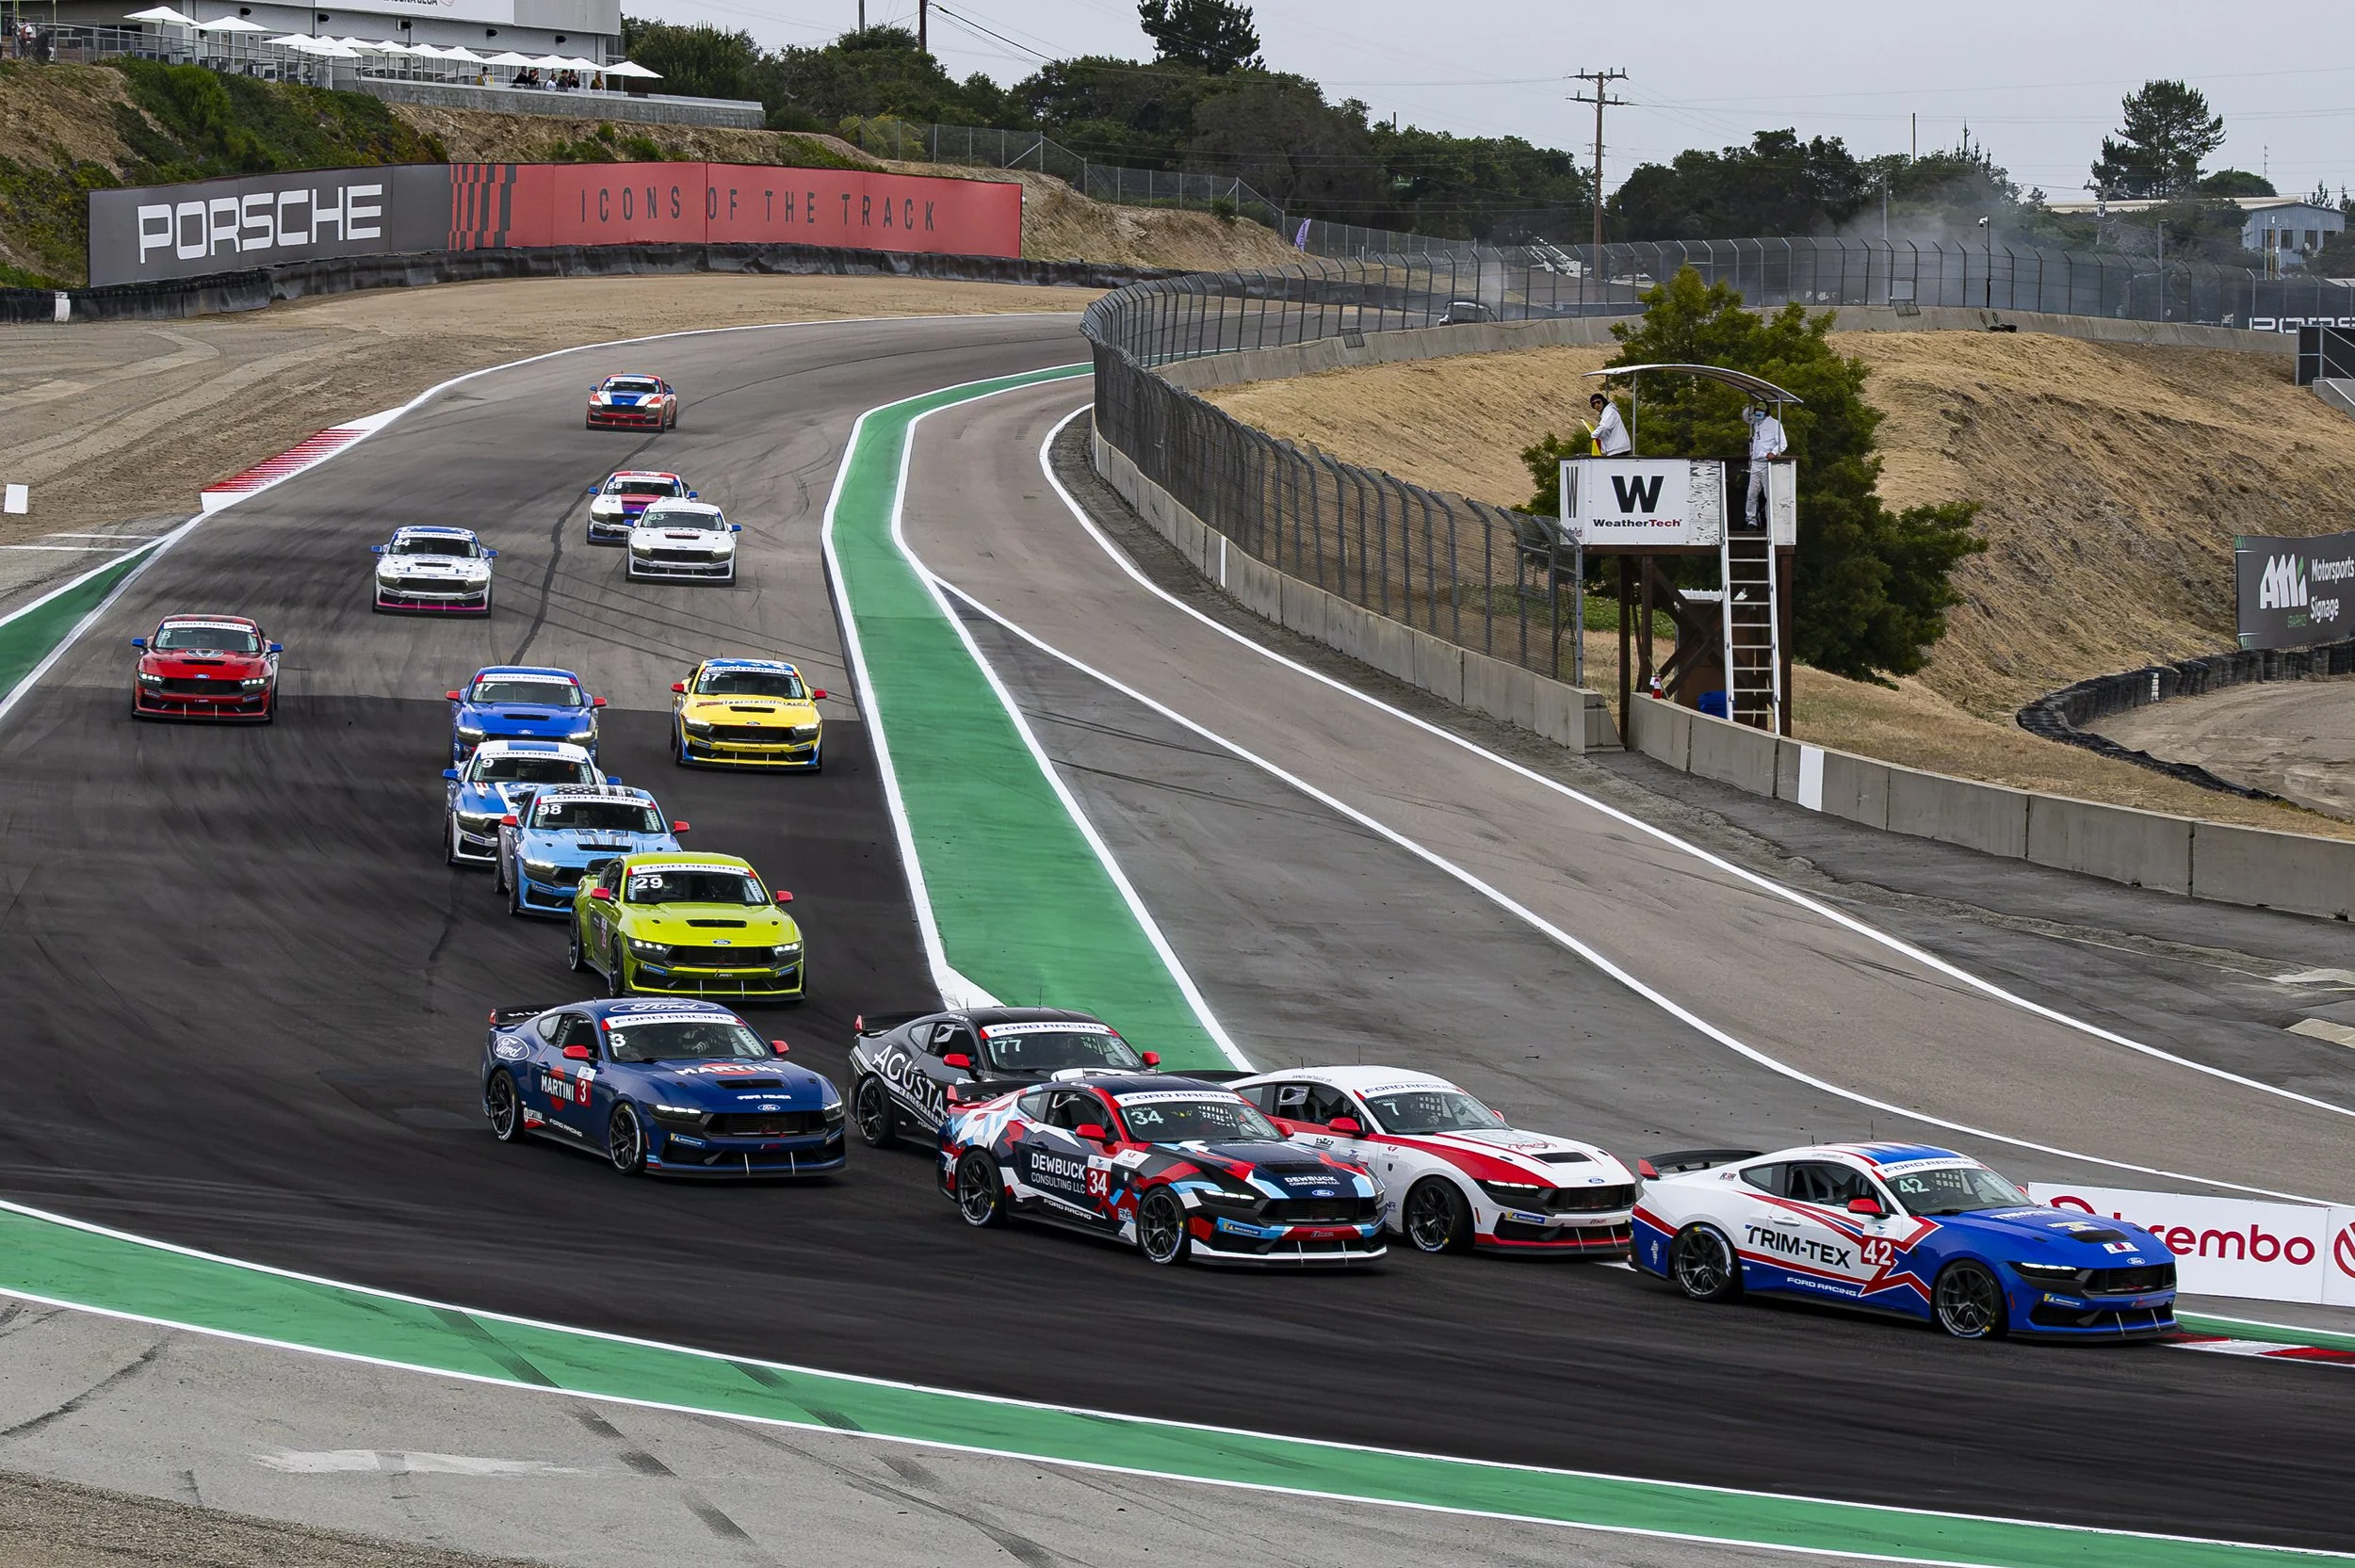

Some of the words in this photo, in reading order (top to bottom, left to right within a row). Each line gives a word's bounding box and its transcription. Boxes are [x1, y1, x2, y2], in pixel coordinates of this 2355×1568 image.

[580, 186, 682, 223] ICONS
[707, 186, 739, 221] OF
[765, 190, 817, 224] THE
[841, 193, 935, 232] TRACK
[138, 184, 382, 264] PORSCHE
[1611, 475, 1665, 513] W
[1593, 519, 1681, 527] WeatherTech
[2312, 556, 2355, 584] Motorsports
[2310, 595, 2339, 623] Signage
[700, 673, 722, 682] 87
[476, 683, 495, 692] 17
[481, 758, 495, 768] 9
[528, 752, 580, 760] RACING
[590, 795, 644, 804] RACING
[537, 804, 562, 816] 98
[685, 865, 744, 873] RACING
[635, 877, 664, 889] 29
[630, 1002, 699, 1010] Ford
[993, 1024, 1040, 1033] FORD
[611, 1033, 626, 1047] 3
[993, 1040, 1022, 1054] 77
[495, 1037, 522, 1059] Ford
[674, 1063, 784, 1075] MARTINI
[541, 1075, 575, 1102] MARTINI
[871, 1044, 950, 1121] AGUSTA
[1365, 1084, 1405, 1093] FORD
[579, 1080, 587, 1103] 3
[1124, 1093, 1172, 1102] FORD
[1175, 1092, 1237, 1101] RACING
[1383, 1103, 1400, 1116] 7
[1130, 1110, 1164, 1125] 34
[549, 1118, 564, 1129] FORD
[563, 1124, 583, 1137] RACING
[1031, 1153, 1086, 1181] DEWBUCK
[1883, 1161, 1924, 1173] FORD
[1031, 1172, 1072, 1192] CONSULTING
[1072, 1183, 1086, 1194] LLC
[1089, 1171, 1108, 1196] 34
[1899, 1178, 1931, 1194] 42
[1044, 1198, 1064, 1210] FORD
[1064, 1205, 1092, 1220] RACING
[1745, 1224, 1851, 1269] TRIM-TEX
[1863, 1239, 1892, 1266] 42
[1787, 1276, 1816, 1287] FORD
[1817, 1283, 1857, 1297] RACING
